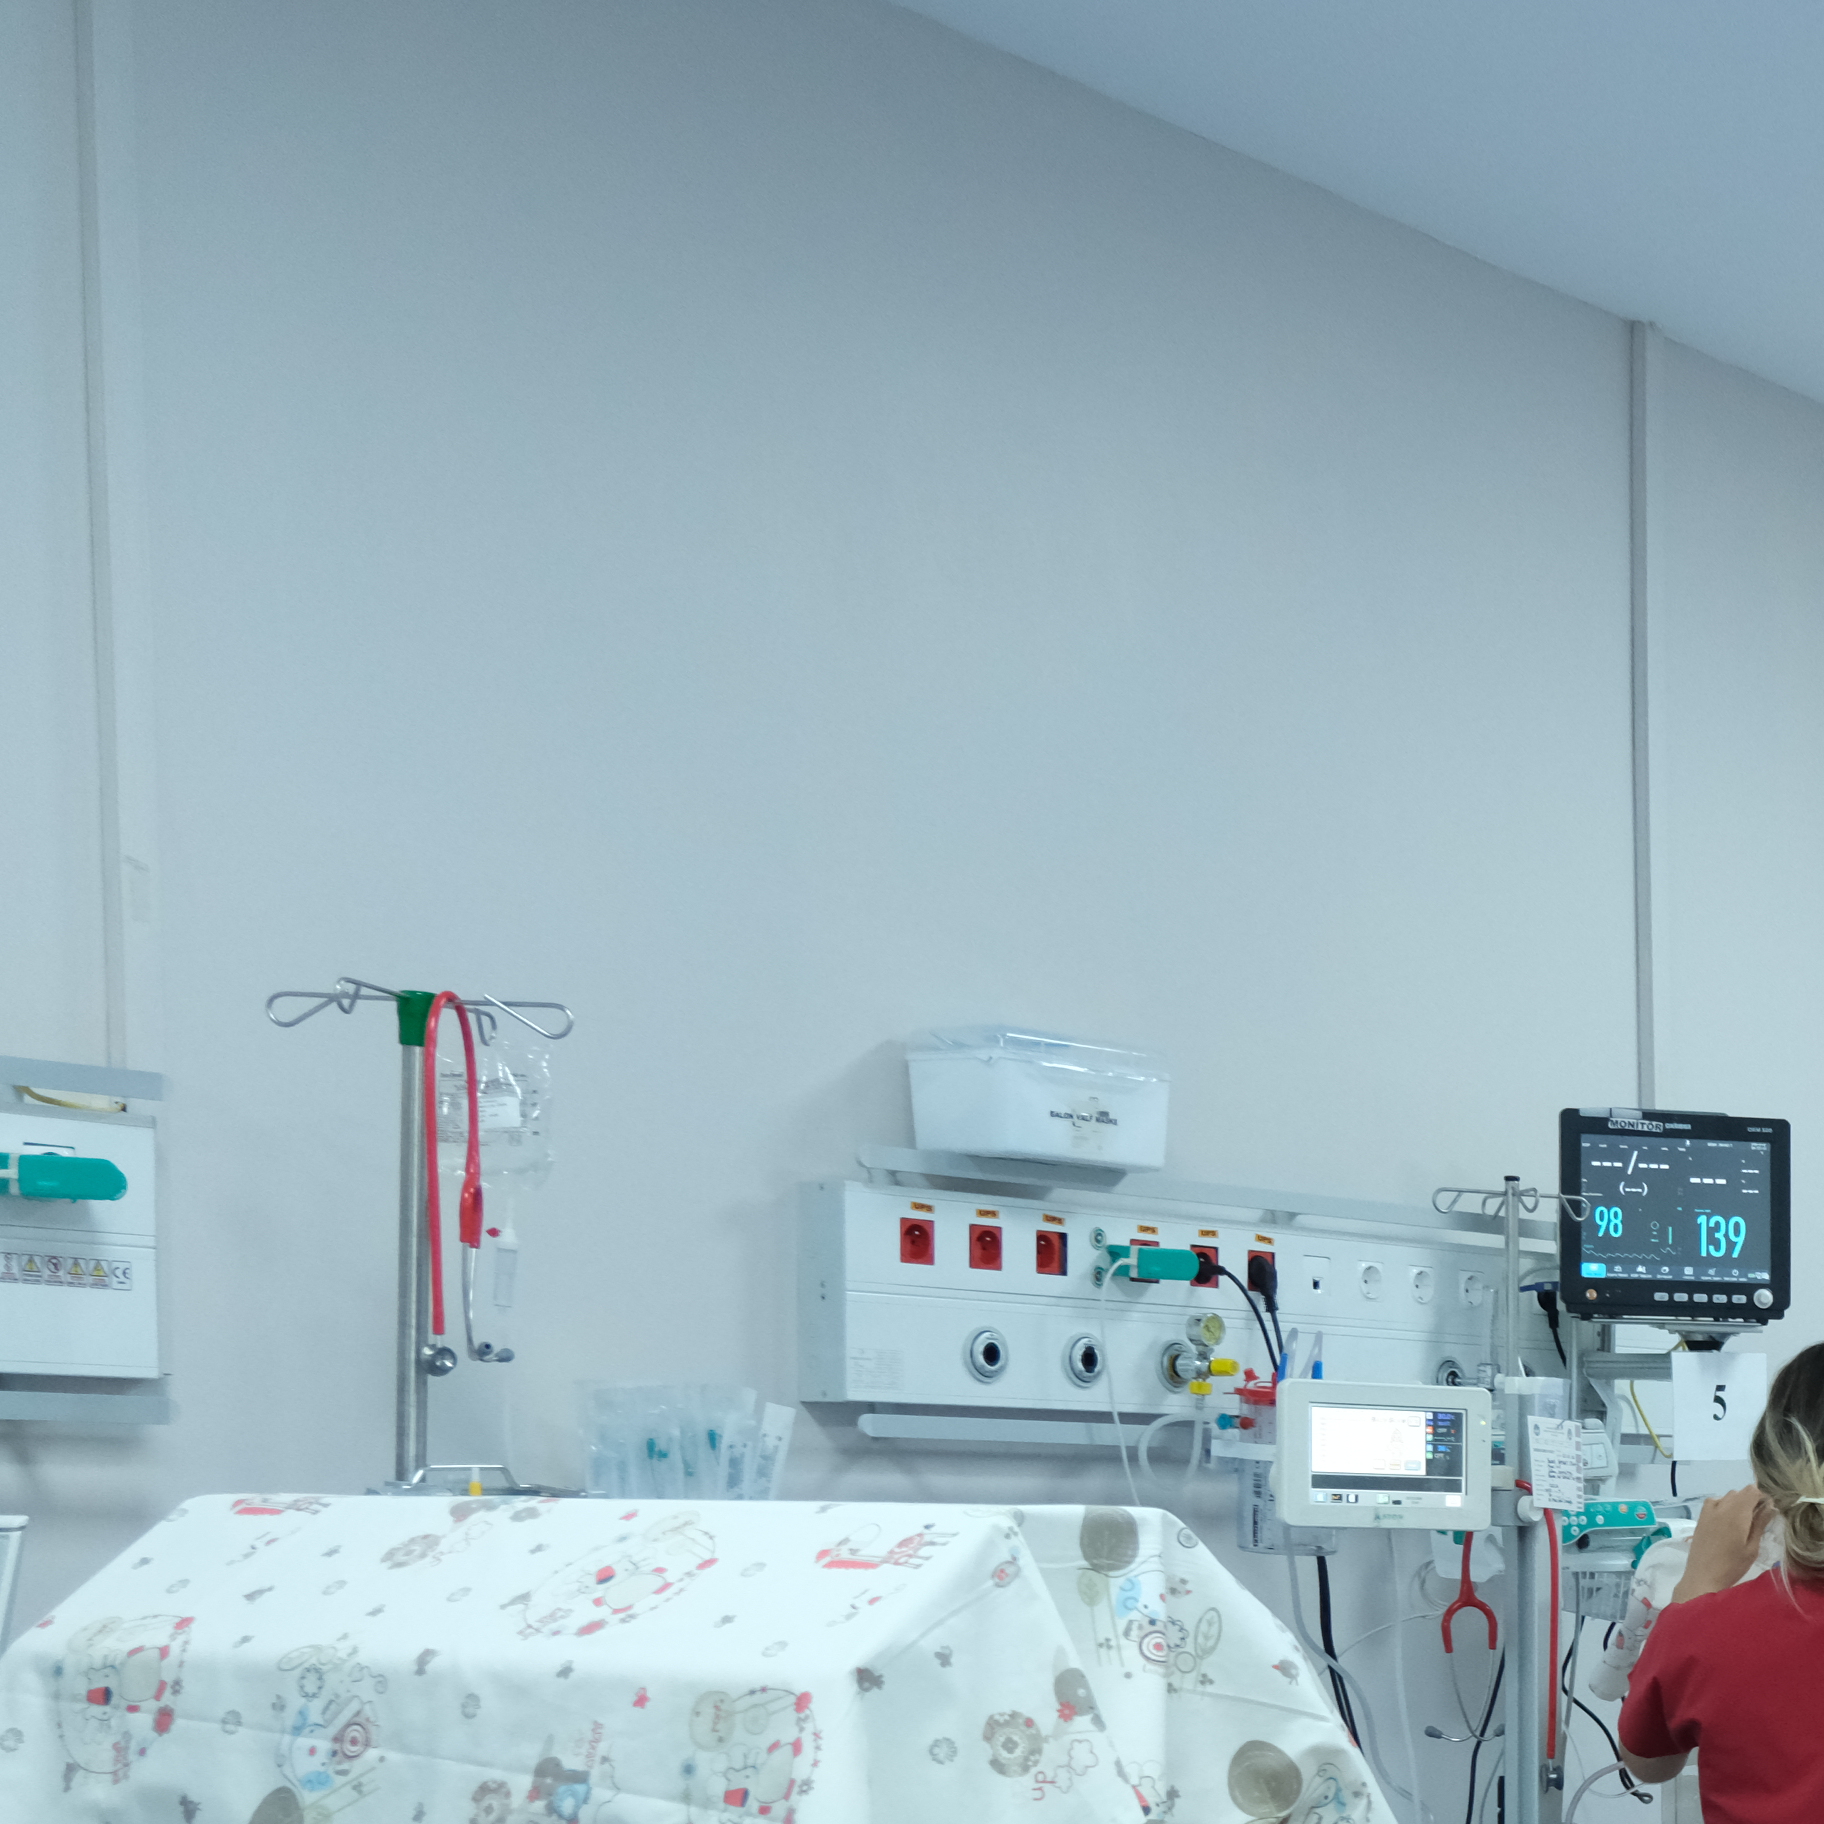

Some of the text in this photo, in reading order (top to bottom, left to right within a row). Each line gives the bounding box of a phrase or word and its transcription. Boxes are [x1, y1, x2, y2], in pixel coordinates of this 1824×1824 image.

[1594, 1206, 1623, 1238] 98
[1696, 1214, 1747, 1259] 139
[1712, 1384, 1727, 1421] 5
